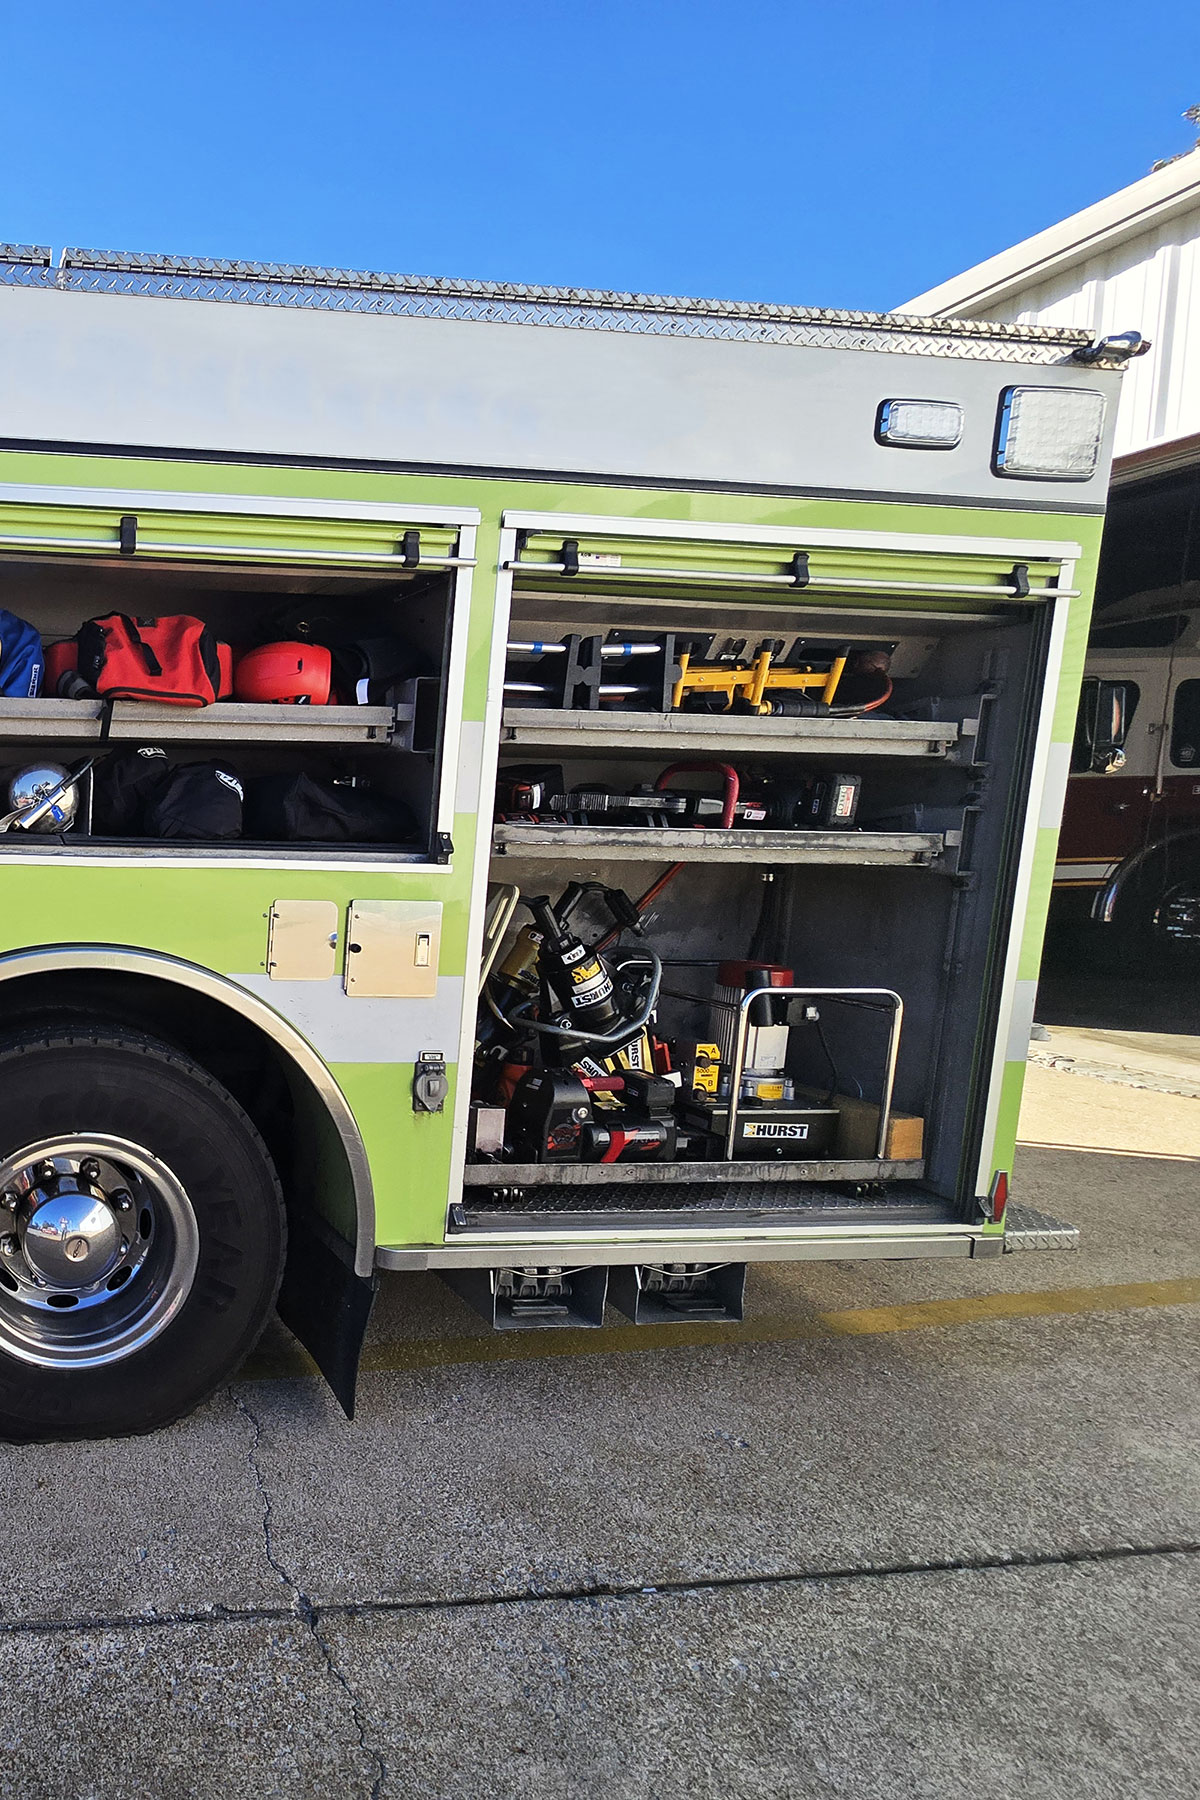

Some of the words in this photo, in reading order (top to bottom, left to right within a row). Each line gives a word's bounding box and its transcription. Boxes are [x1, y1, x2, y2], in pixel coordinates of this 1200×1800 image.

[574, 983, 612, 1006] HURST
[630, 1041, 640, 1068] URST
[581, 1060, 600, 1077] URS
[756, 1124, 807, 1137] HURST
